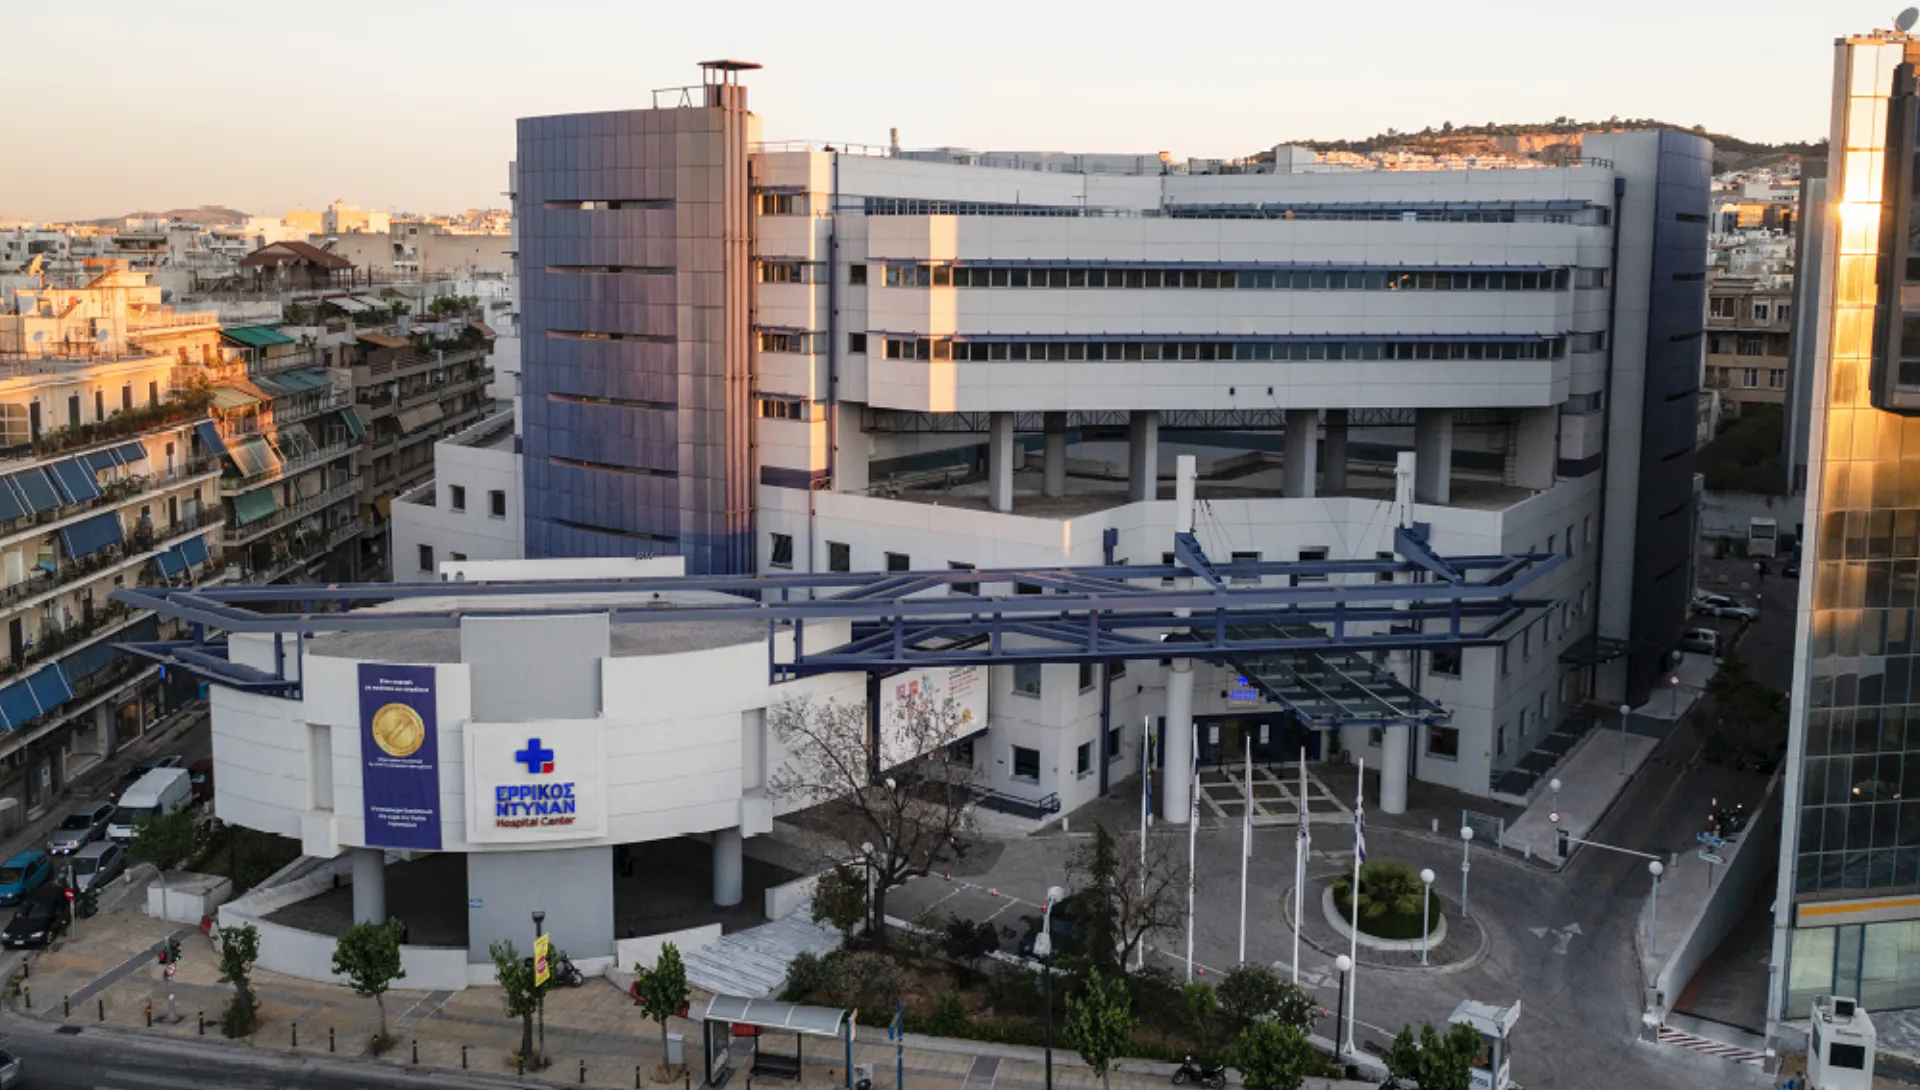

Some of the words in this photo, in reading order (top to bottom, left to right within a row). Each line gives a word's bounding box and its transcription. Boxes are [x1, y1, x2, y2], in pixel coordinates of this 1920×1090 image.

[496, 782, 575, 801] ΕΡΡΙΚΟΣ
[496, 800, 575, 816] ΝΤΥΝΑΝ
[496, 818, 538, 829] Hospital
[541, 816, 575, 826] Center
